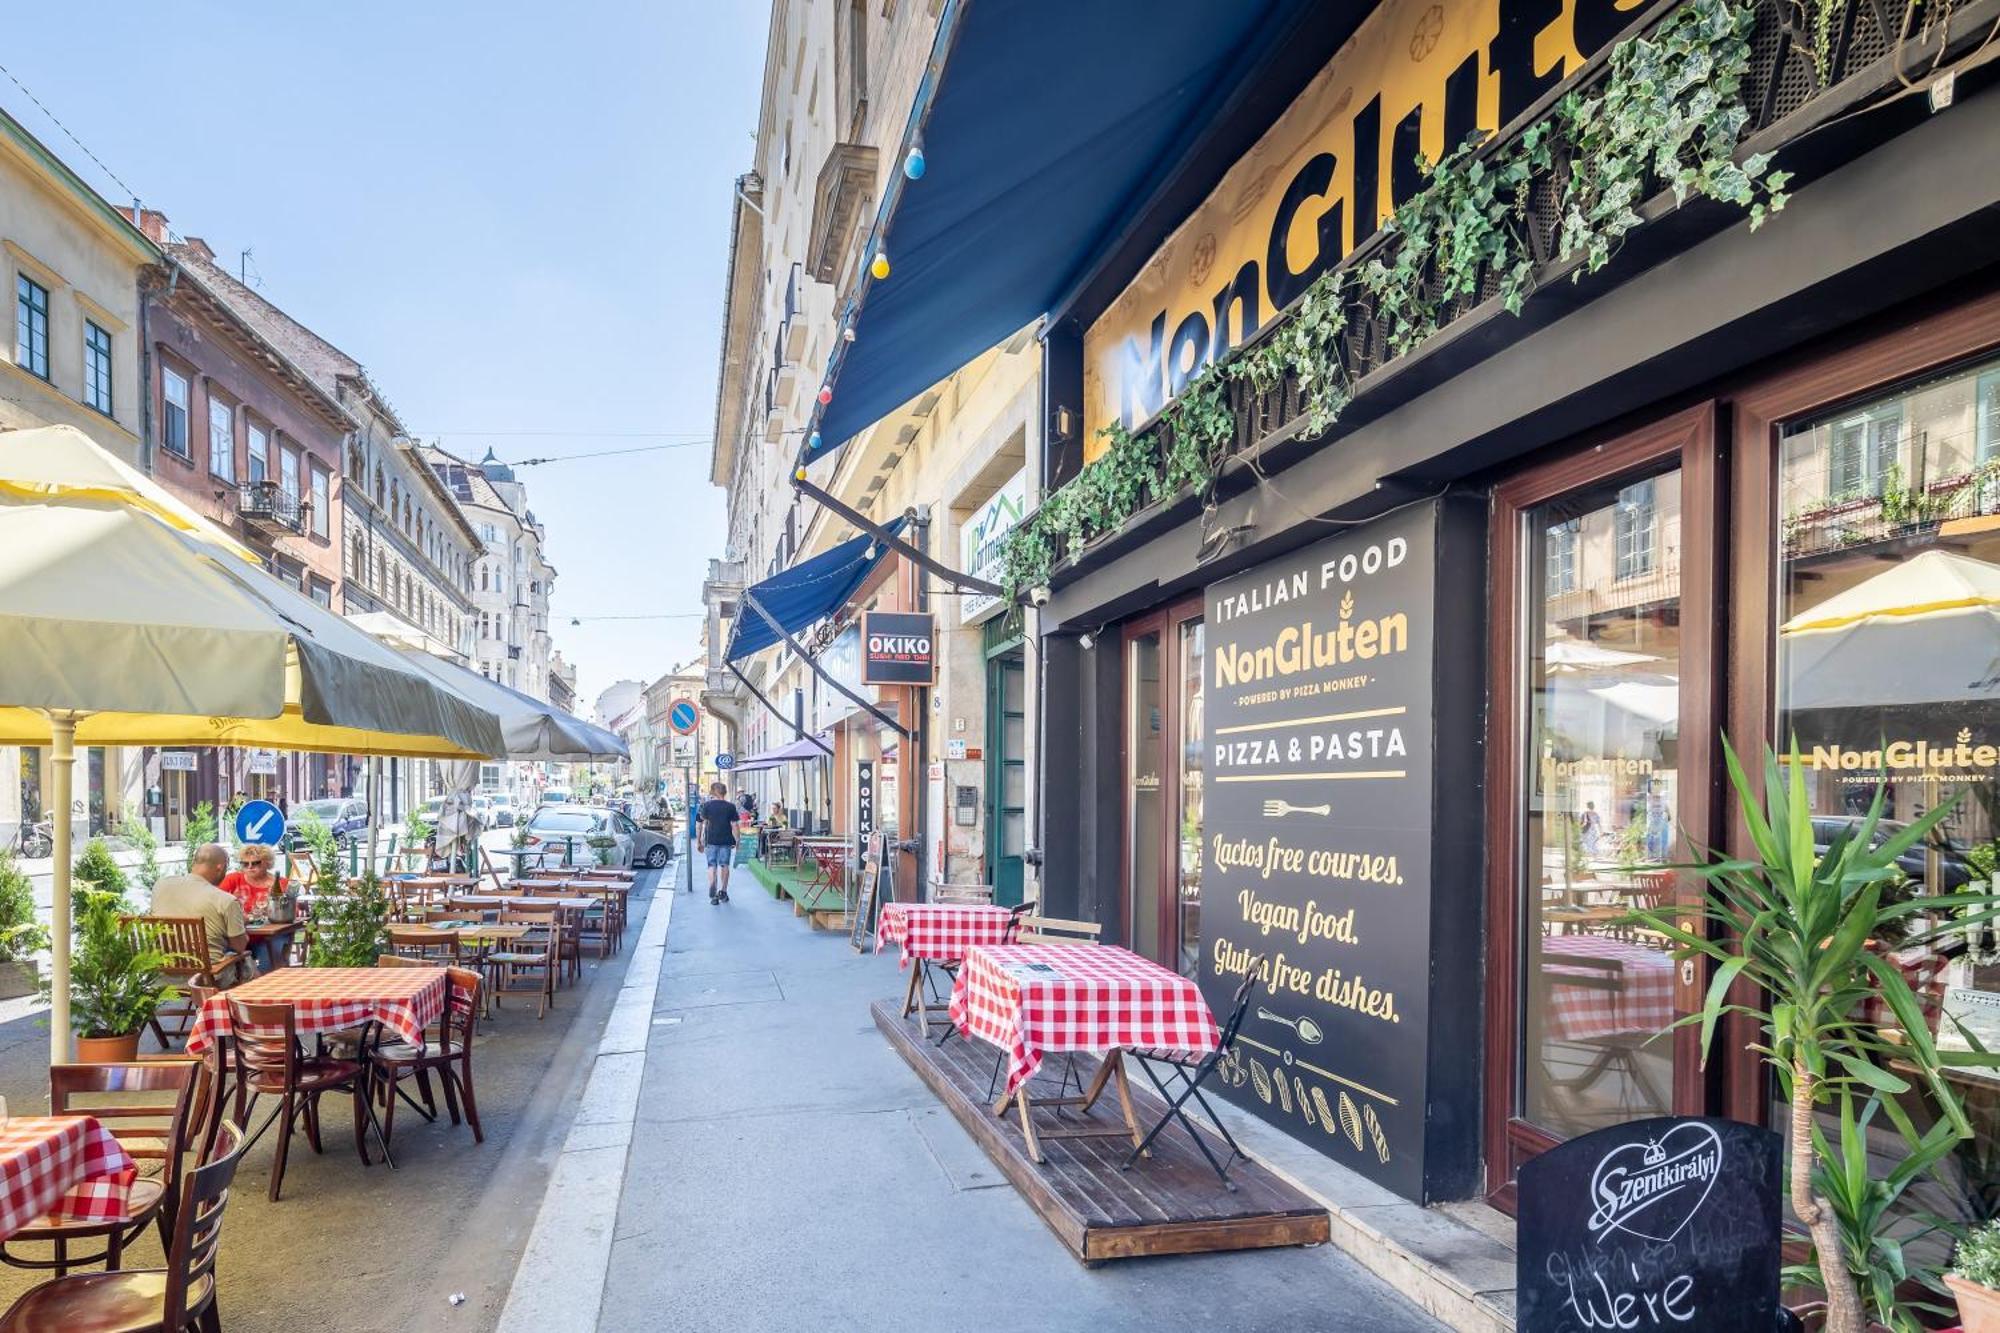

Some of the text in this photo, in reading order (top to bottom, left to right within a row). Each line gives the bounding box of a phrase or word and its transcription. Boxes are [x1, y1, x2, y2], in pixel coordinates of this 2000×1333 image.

[1217, 537, 1407, 623] ITALIAN FOOD
[868, 637, 930, 654] OKIKO
[1215, 612, 1408, 689] NonGluten
[1238, 675, 1368, 707] POWERED BY PIZZA MONKEY
[1215, 727, 1407, 767] PIZZA & PASTA
[1939, 774, 1986, 783] MONKEY
[860, 787, 872, 843] OKIKO
[1212, 832, 1404, 885] Lactos free courses.
[1238, 888, 1359, 946] Vegan food.
[1267, 952, 1313, 996] free
[1315, 968, 1400, 1025] dishes.
[1588, 1151, 1715, 1231] Szentkirályi
